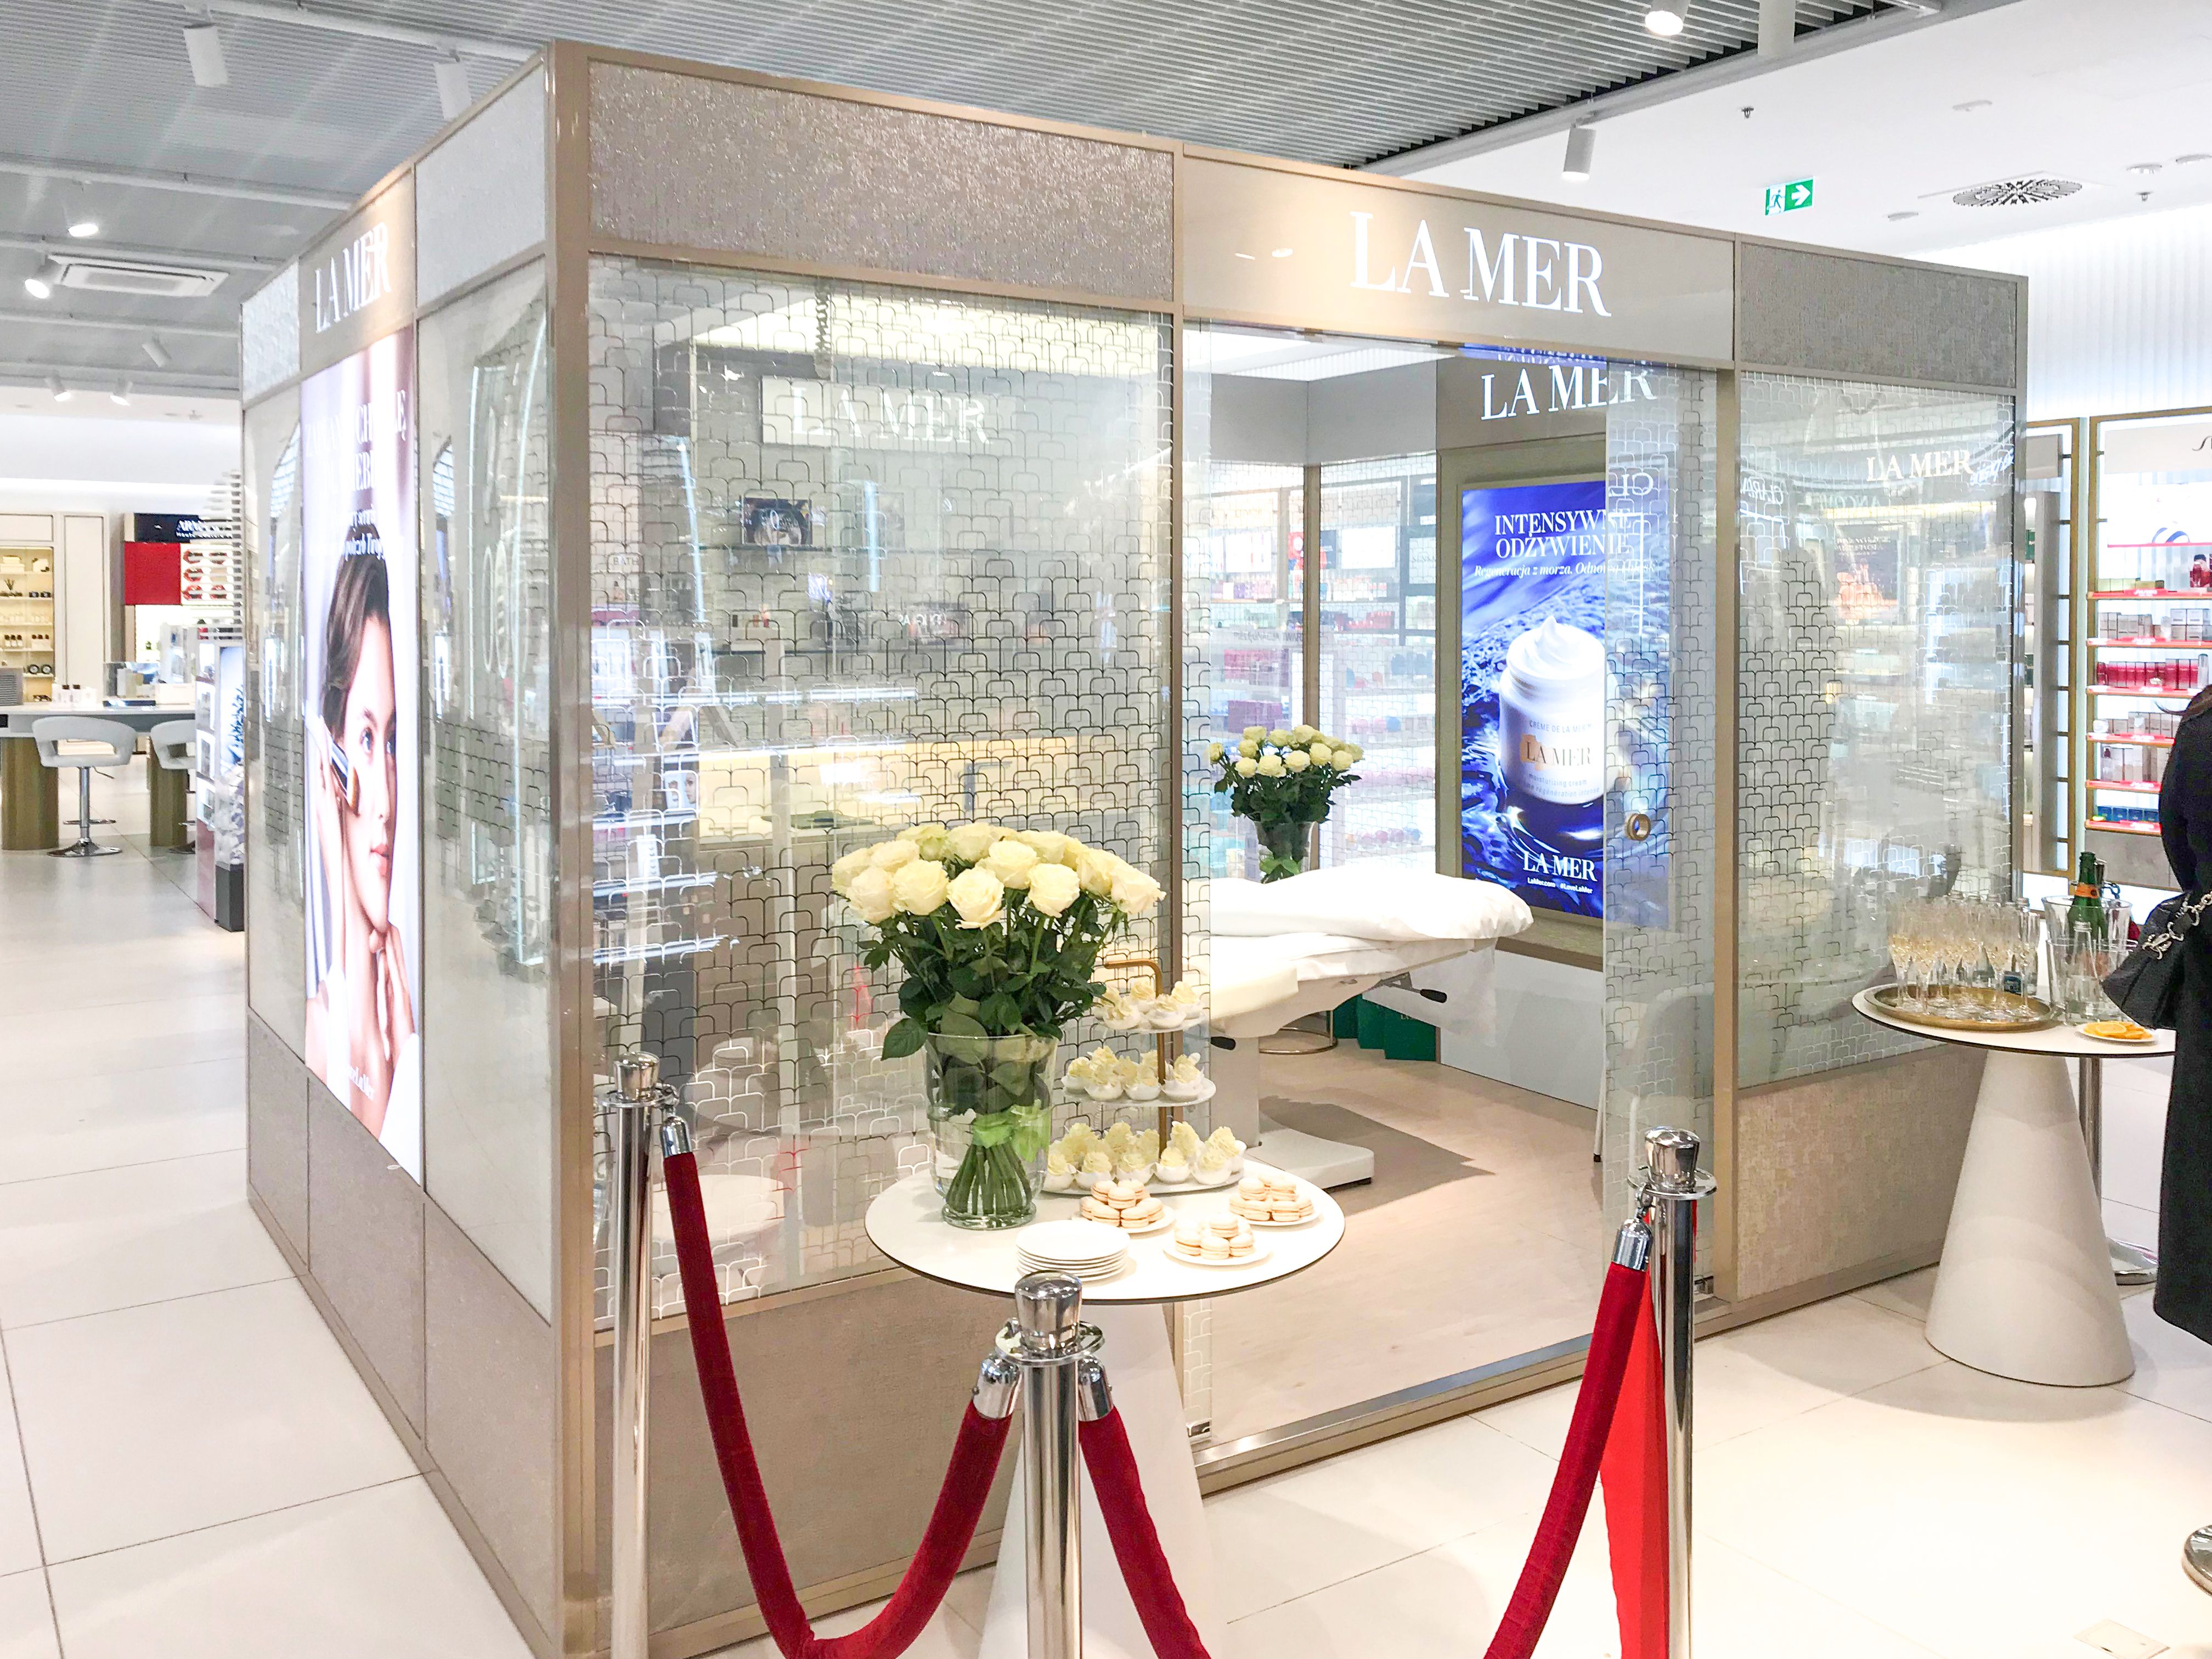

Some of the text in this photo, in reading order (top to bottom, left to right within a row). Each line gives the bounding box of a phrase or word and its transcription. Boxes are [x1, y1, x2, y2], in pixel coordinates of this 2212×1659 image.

[315, 222, 392, 334] LA MER
[1349, 211, 1612, 317] LA MER
[1481, 364, 1657, 420] LA MER
[790, 386, 994, 445] LA MER
[1866, 454, 1904, 482] LA
[1909, 449, 1974, 478] MER
[1494, 508, 1632, 536] INTENSYWNE
[1496, 533, 1630, 559] ODŻYWIENIE
[1474, 564, 1531, 579] Regeneracja
[1532, 567, 1538, 575] z
[1539, 565, 1573, 576] morza.
[1551, 725, 1560, 733] DE
[1526, 741, 1591, 766] LA MER
[1523, 851, 1598, 882] LA MER
